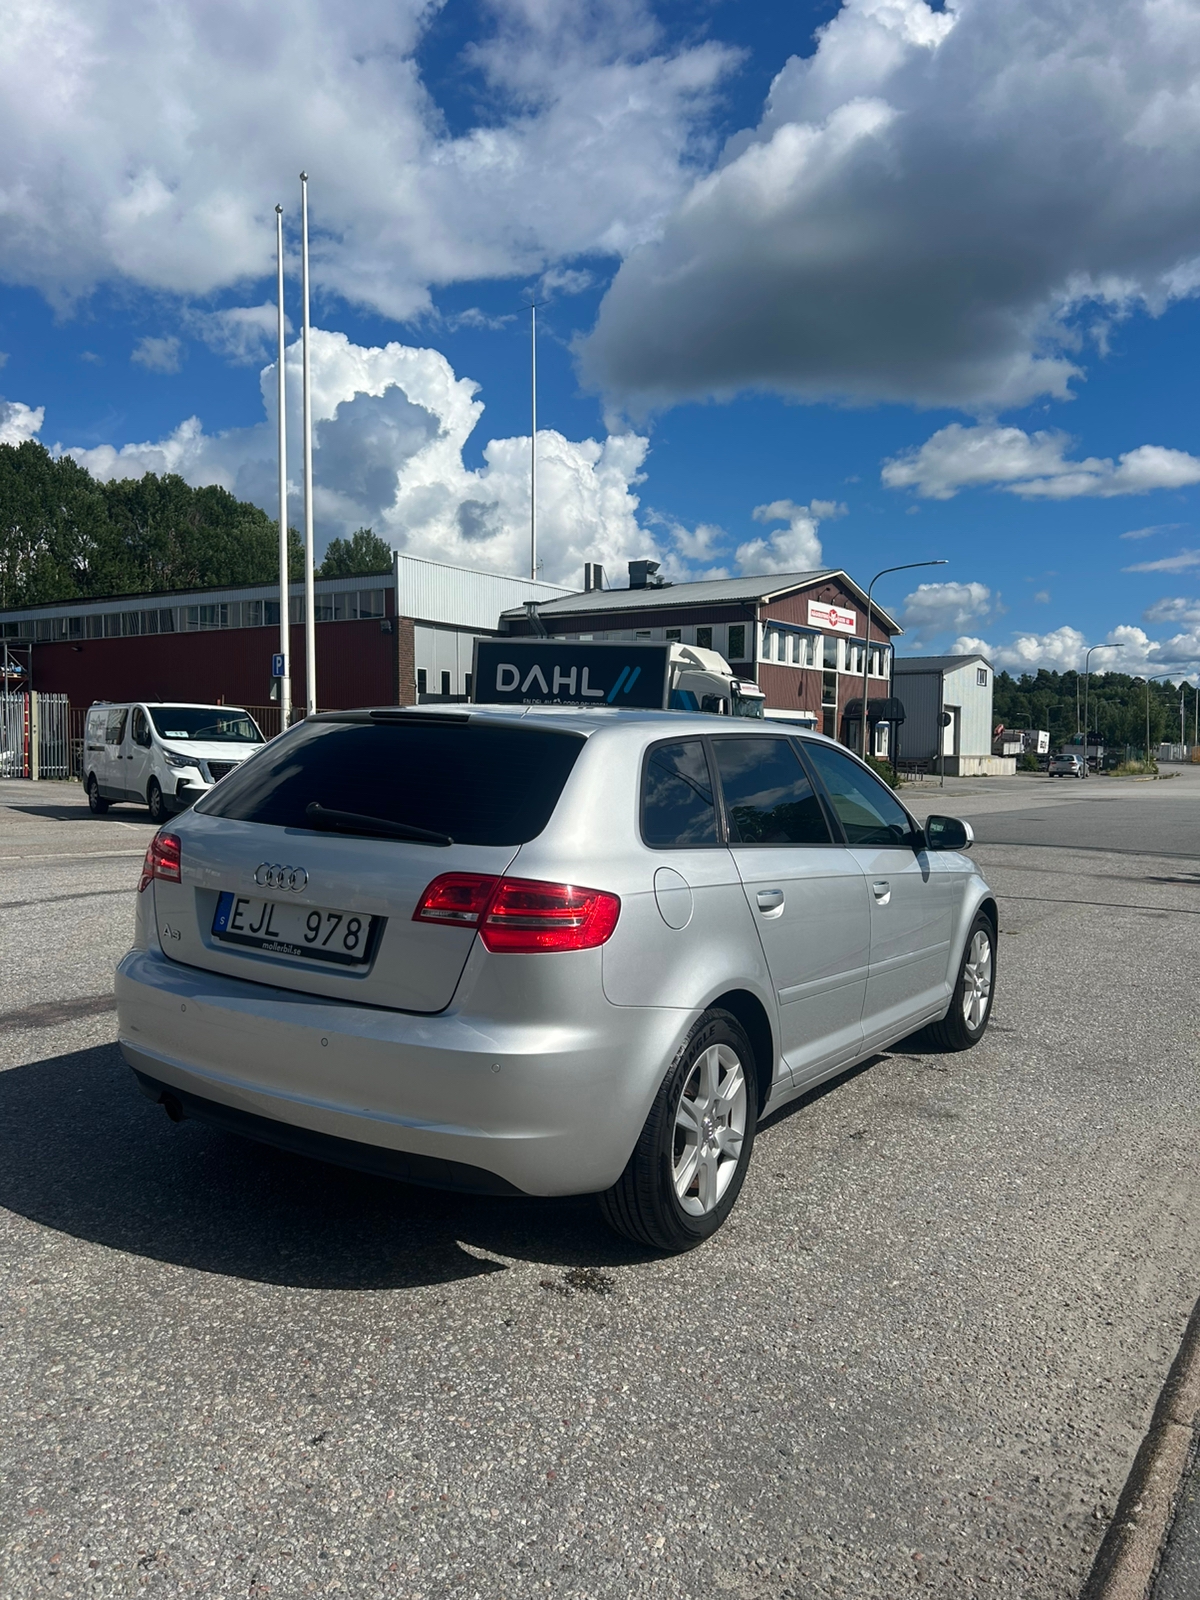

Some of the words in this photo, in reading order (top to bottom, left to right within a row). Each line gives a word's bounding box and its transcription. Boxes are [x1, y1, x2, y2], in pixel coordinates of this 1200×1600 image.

[276, 656, 283, 675] P
[495, 663, 605, 697] DAHL
[219, 916, 225, 925] S
[230, 898, 280, 938] EJL
[303, 910, 362, 950] 978
[161, 922, 182, 941] A3
